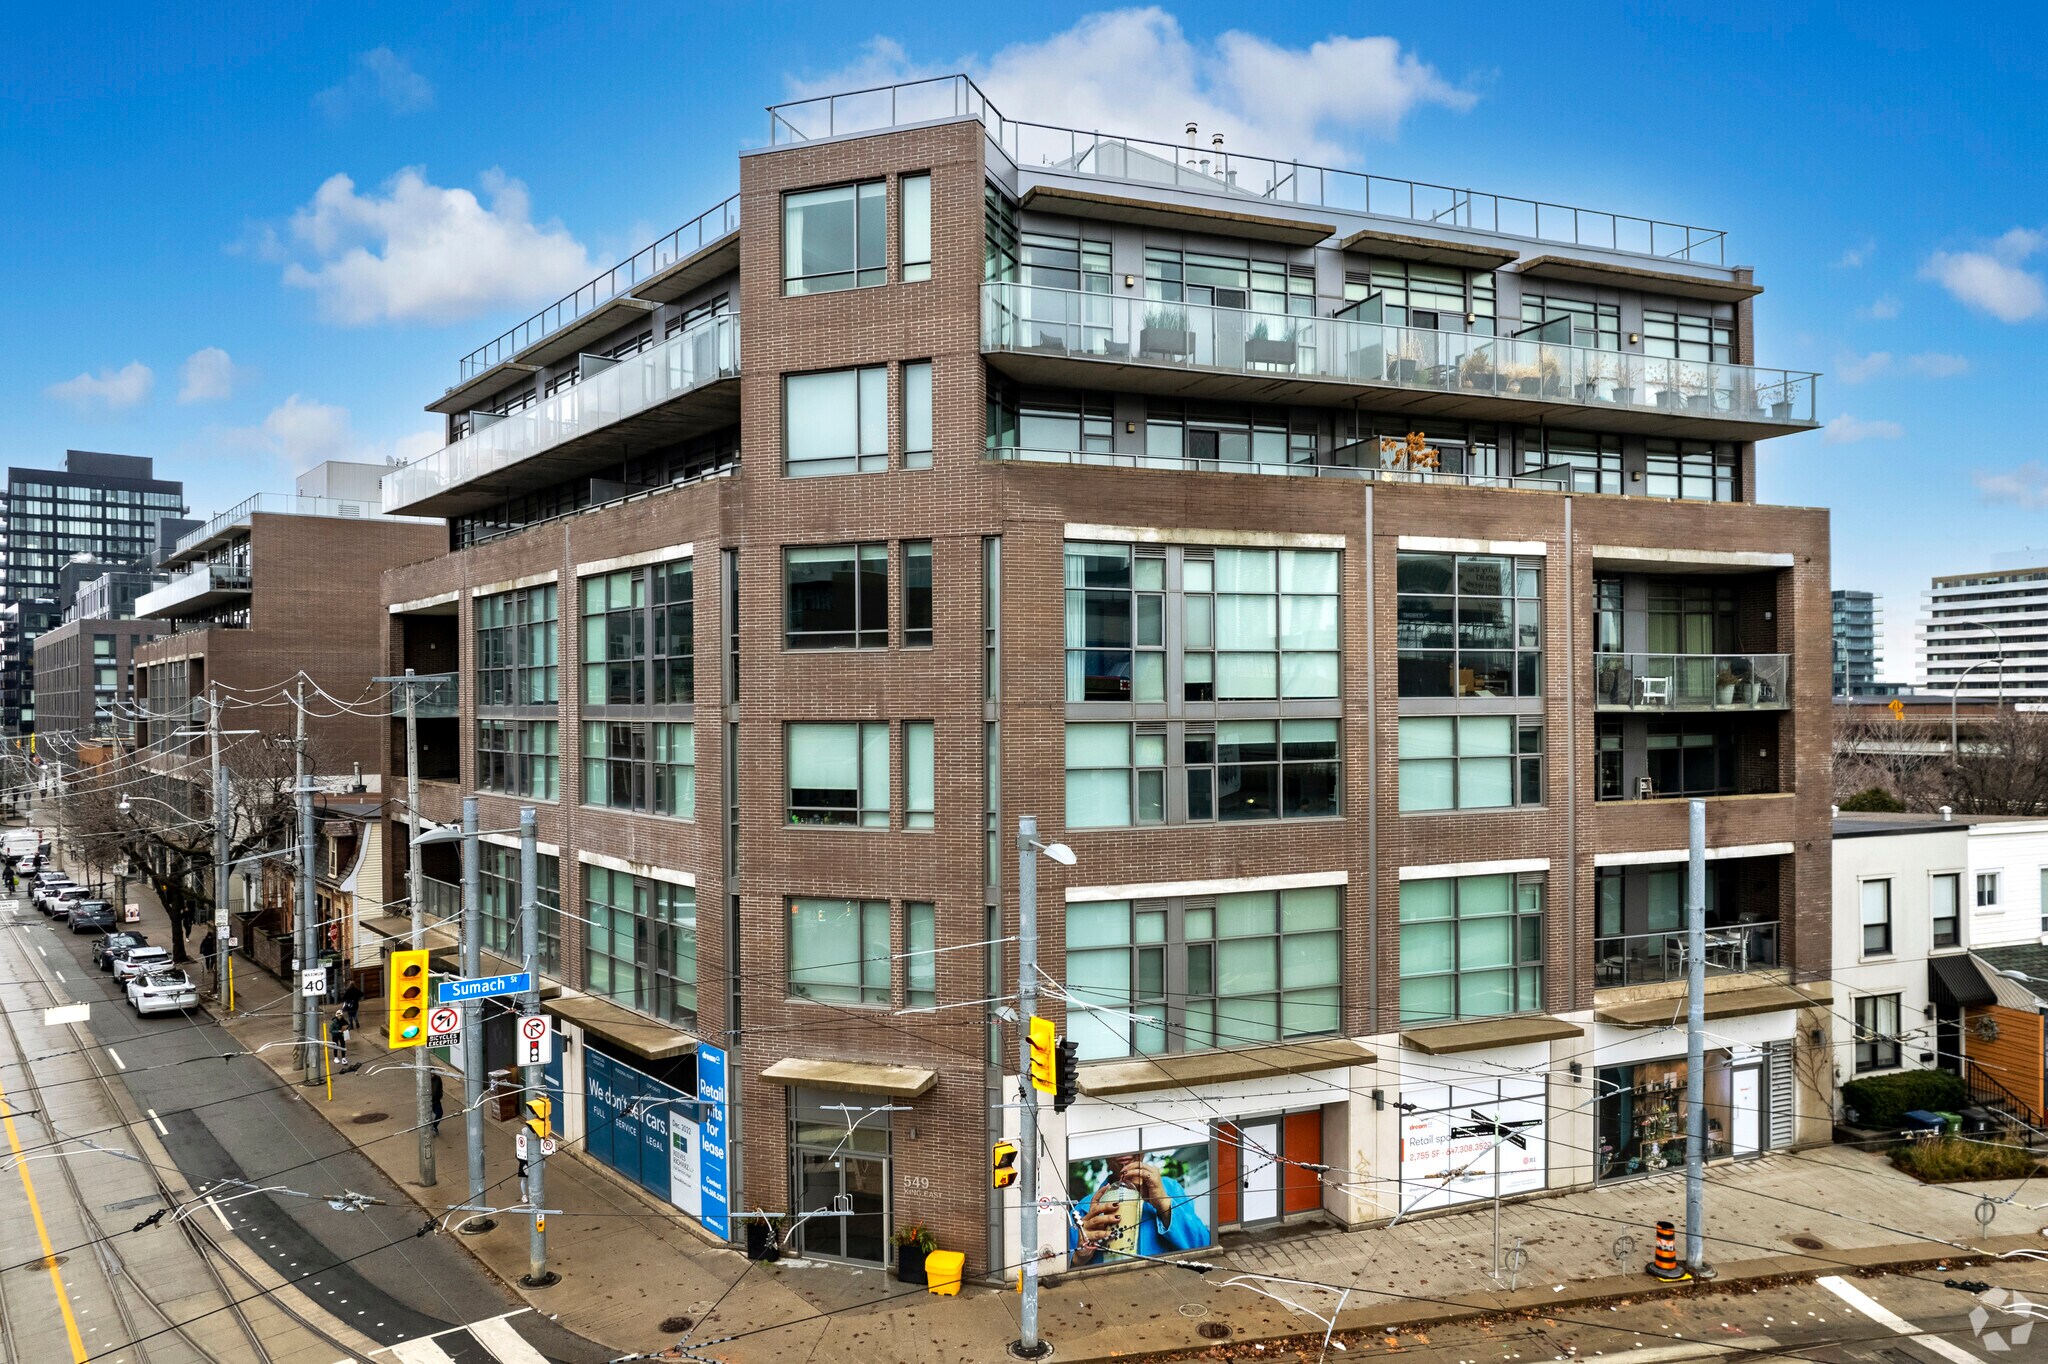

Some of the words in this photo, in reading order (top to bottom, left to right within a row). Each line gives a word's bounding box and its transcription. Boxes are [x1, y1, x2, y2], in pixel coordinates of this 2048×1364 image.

[304, 980, 324, 992] 40
[452, 978, 506, 997] Sumach
[510, 975, 518, 983] St
[428, 1038, 458, 1047] EXCEPTED
[429, 1033, 458, 1042] BICYCLES
[700, 1078, 724, 1103] Retail
[588, 1077, 604, 1101] We
[645, 1112, 668, 1137] cars.
[593, 1105, 606, 1119] FULL
[615, 1118, 637, 1137] SERVICE
[645, 1134, 664, 1152] LEGAL
[706, 1118, 719, 1137] for
[1409, 1123, 1428, 1131] dream
[702, 1134, 724, 1160] lease
[1409, 1134, 1434, 1147] Retail
[1409, 1151, 1430, 1162] 2,755
[1431, 1149, 1441, 1158] SF
[903, 1175, 930, 1190] 549
[923, 1190, 943, 1199] EAST
